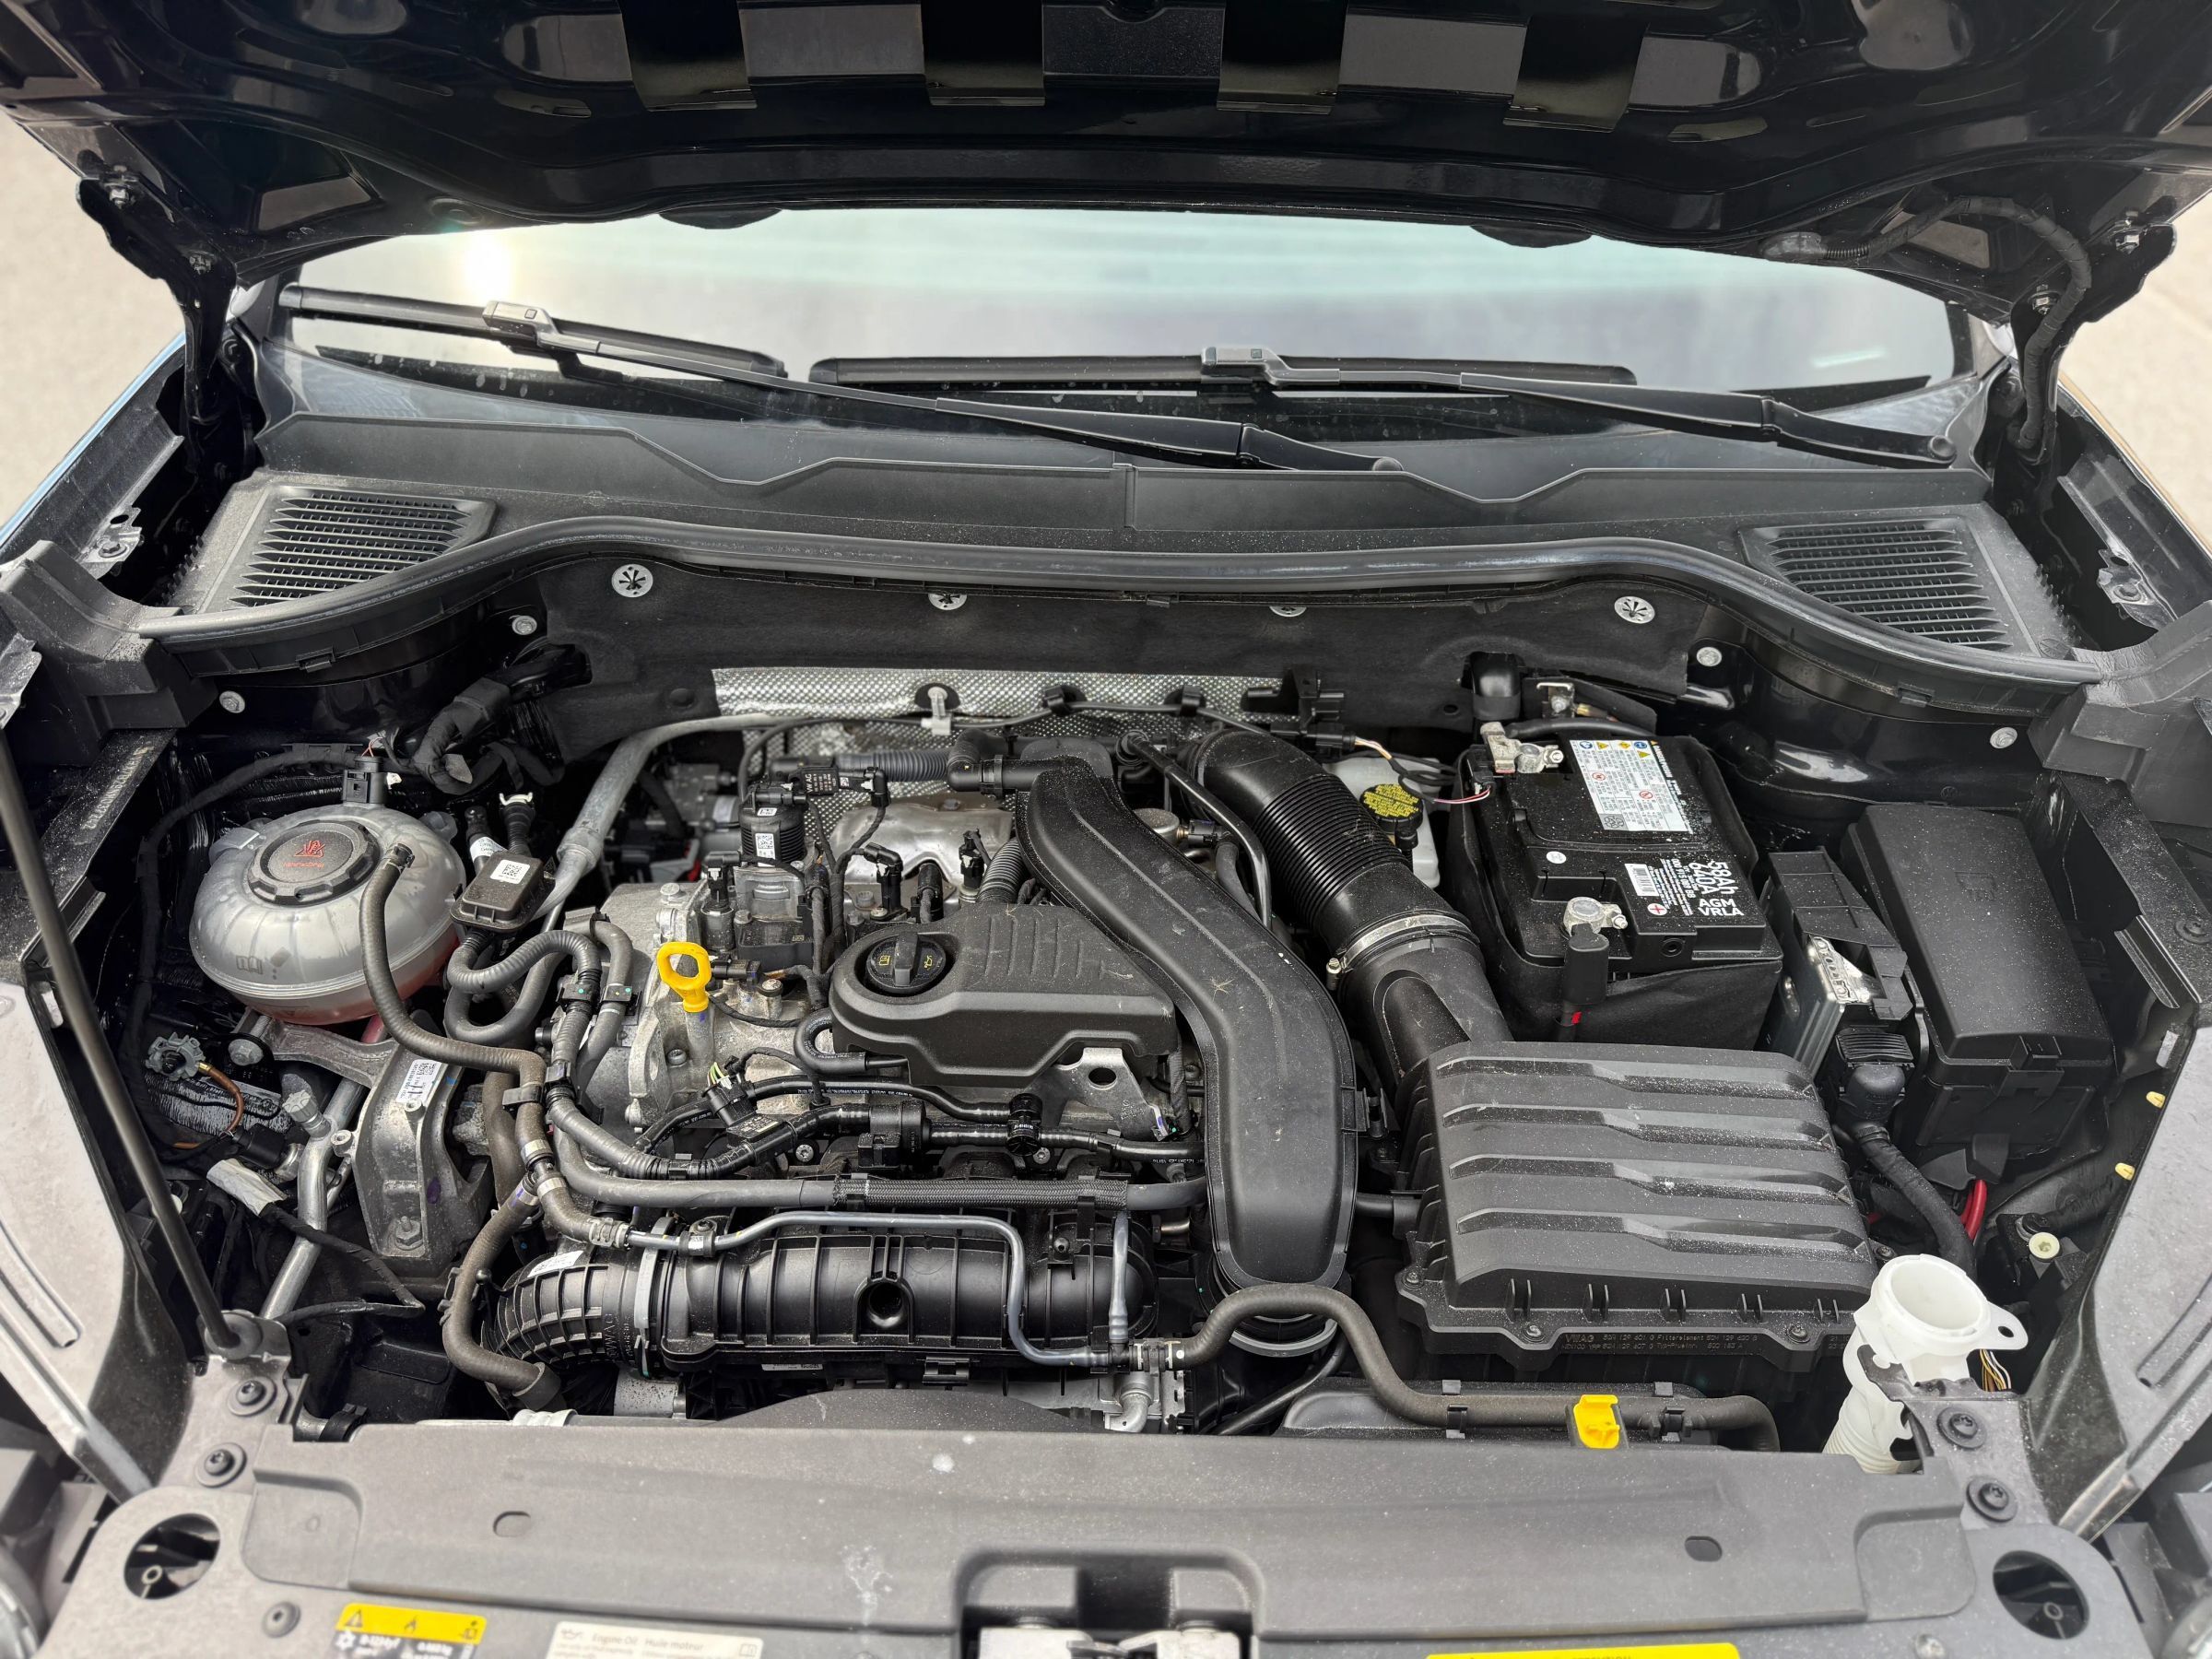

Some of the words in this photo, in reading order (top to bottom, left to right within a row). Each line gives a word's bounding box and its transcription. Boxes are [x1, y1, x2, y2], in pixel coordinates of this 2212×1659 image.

[1688, 862, 1720, 894] 640A
[1707, 861, 1738, 894] 58Ah
[1697, 907, 1745, 916] VRLA
[1699, 898, 1736, 907] AGM
[592, 1634, 623, 1644] Engine
[625, 1635, 638, 1644] Oil
[645, 1638, 668, 1648] Huile
[670, 1641, 704, 1652] moteur
